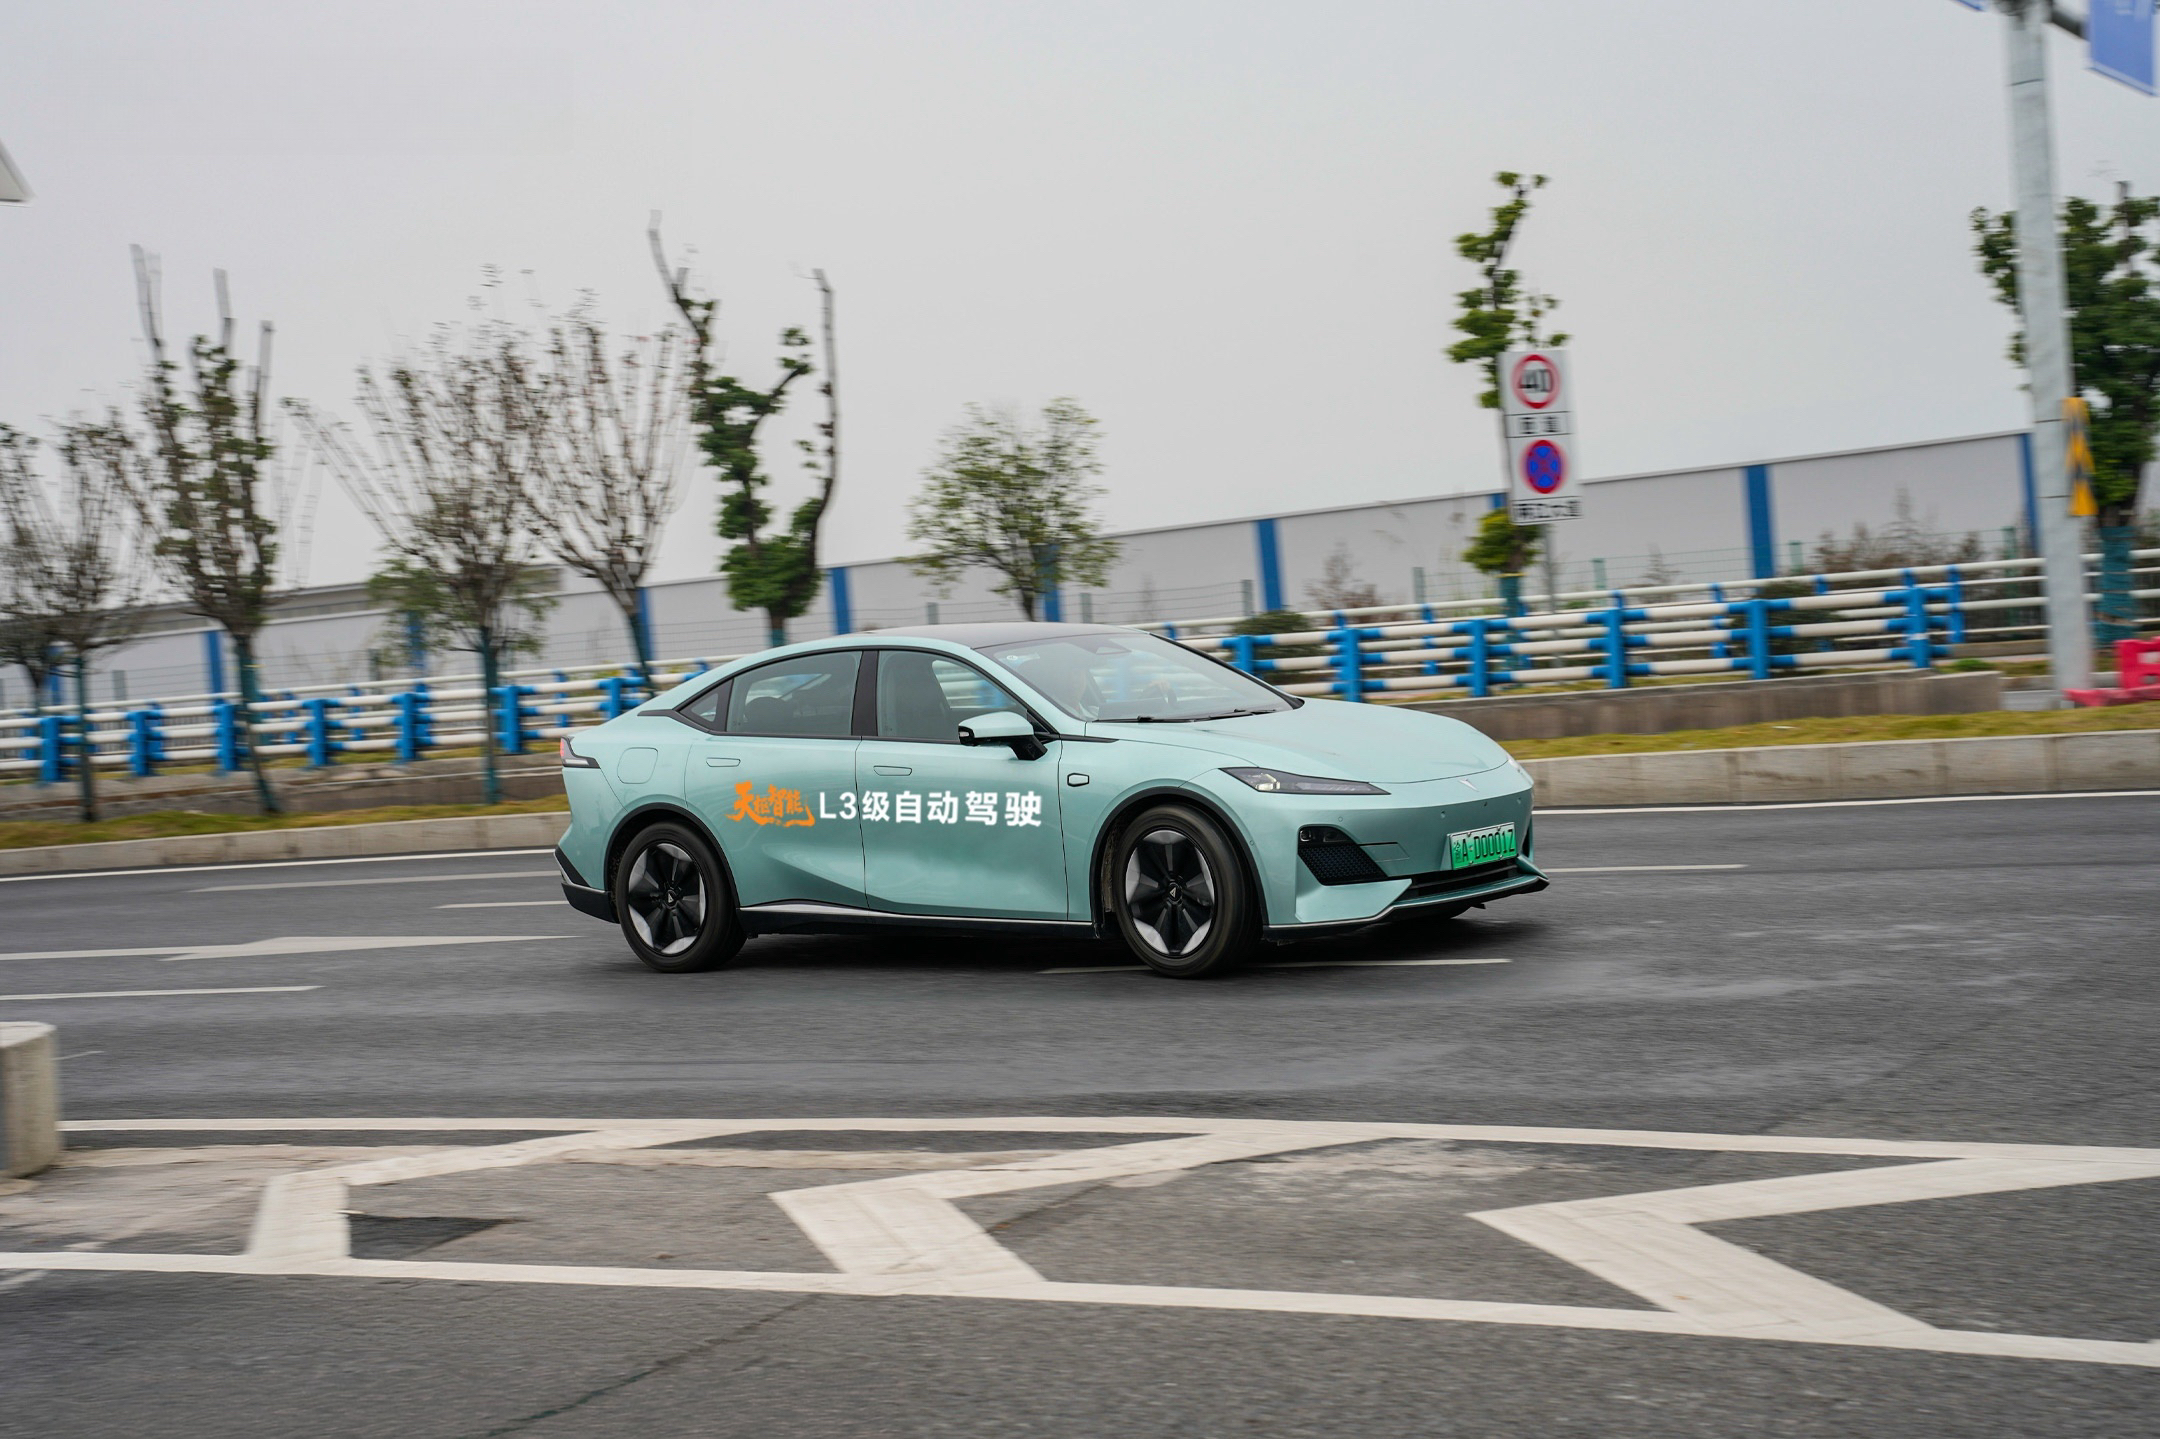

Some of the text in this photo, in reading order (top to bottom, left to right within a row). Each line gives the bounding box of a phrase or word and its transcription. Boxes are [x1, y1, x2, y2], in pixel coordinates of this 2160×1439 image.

[819, 791, 1042, 827] L3级自动驾驶
